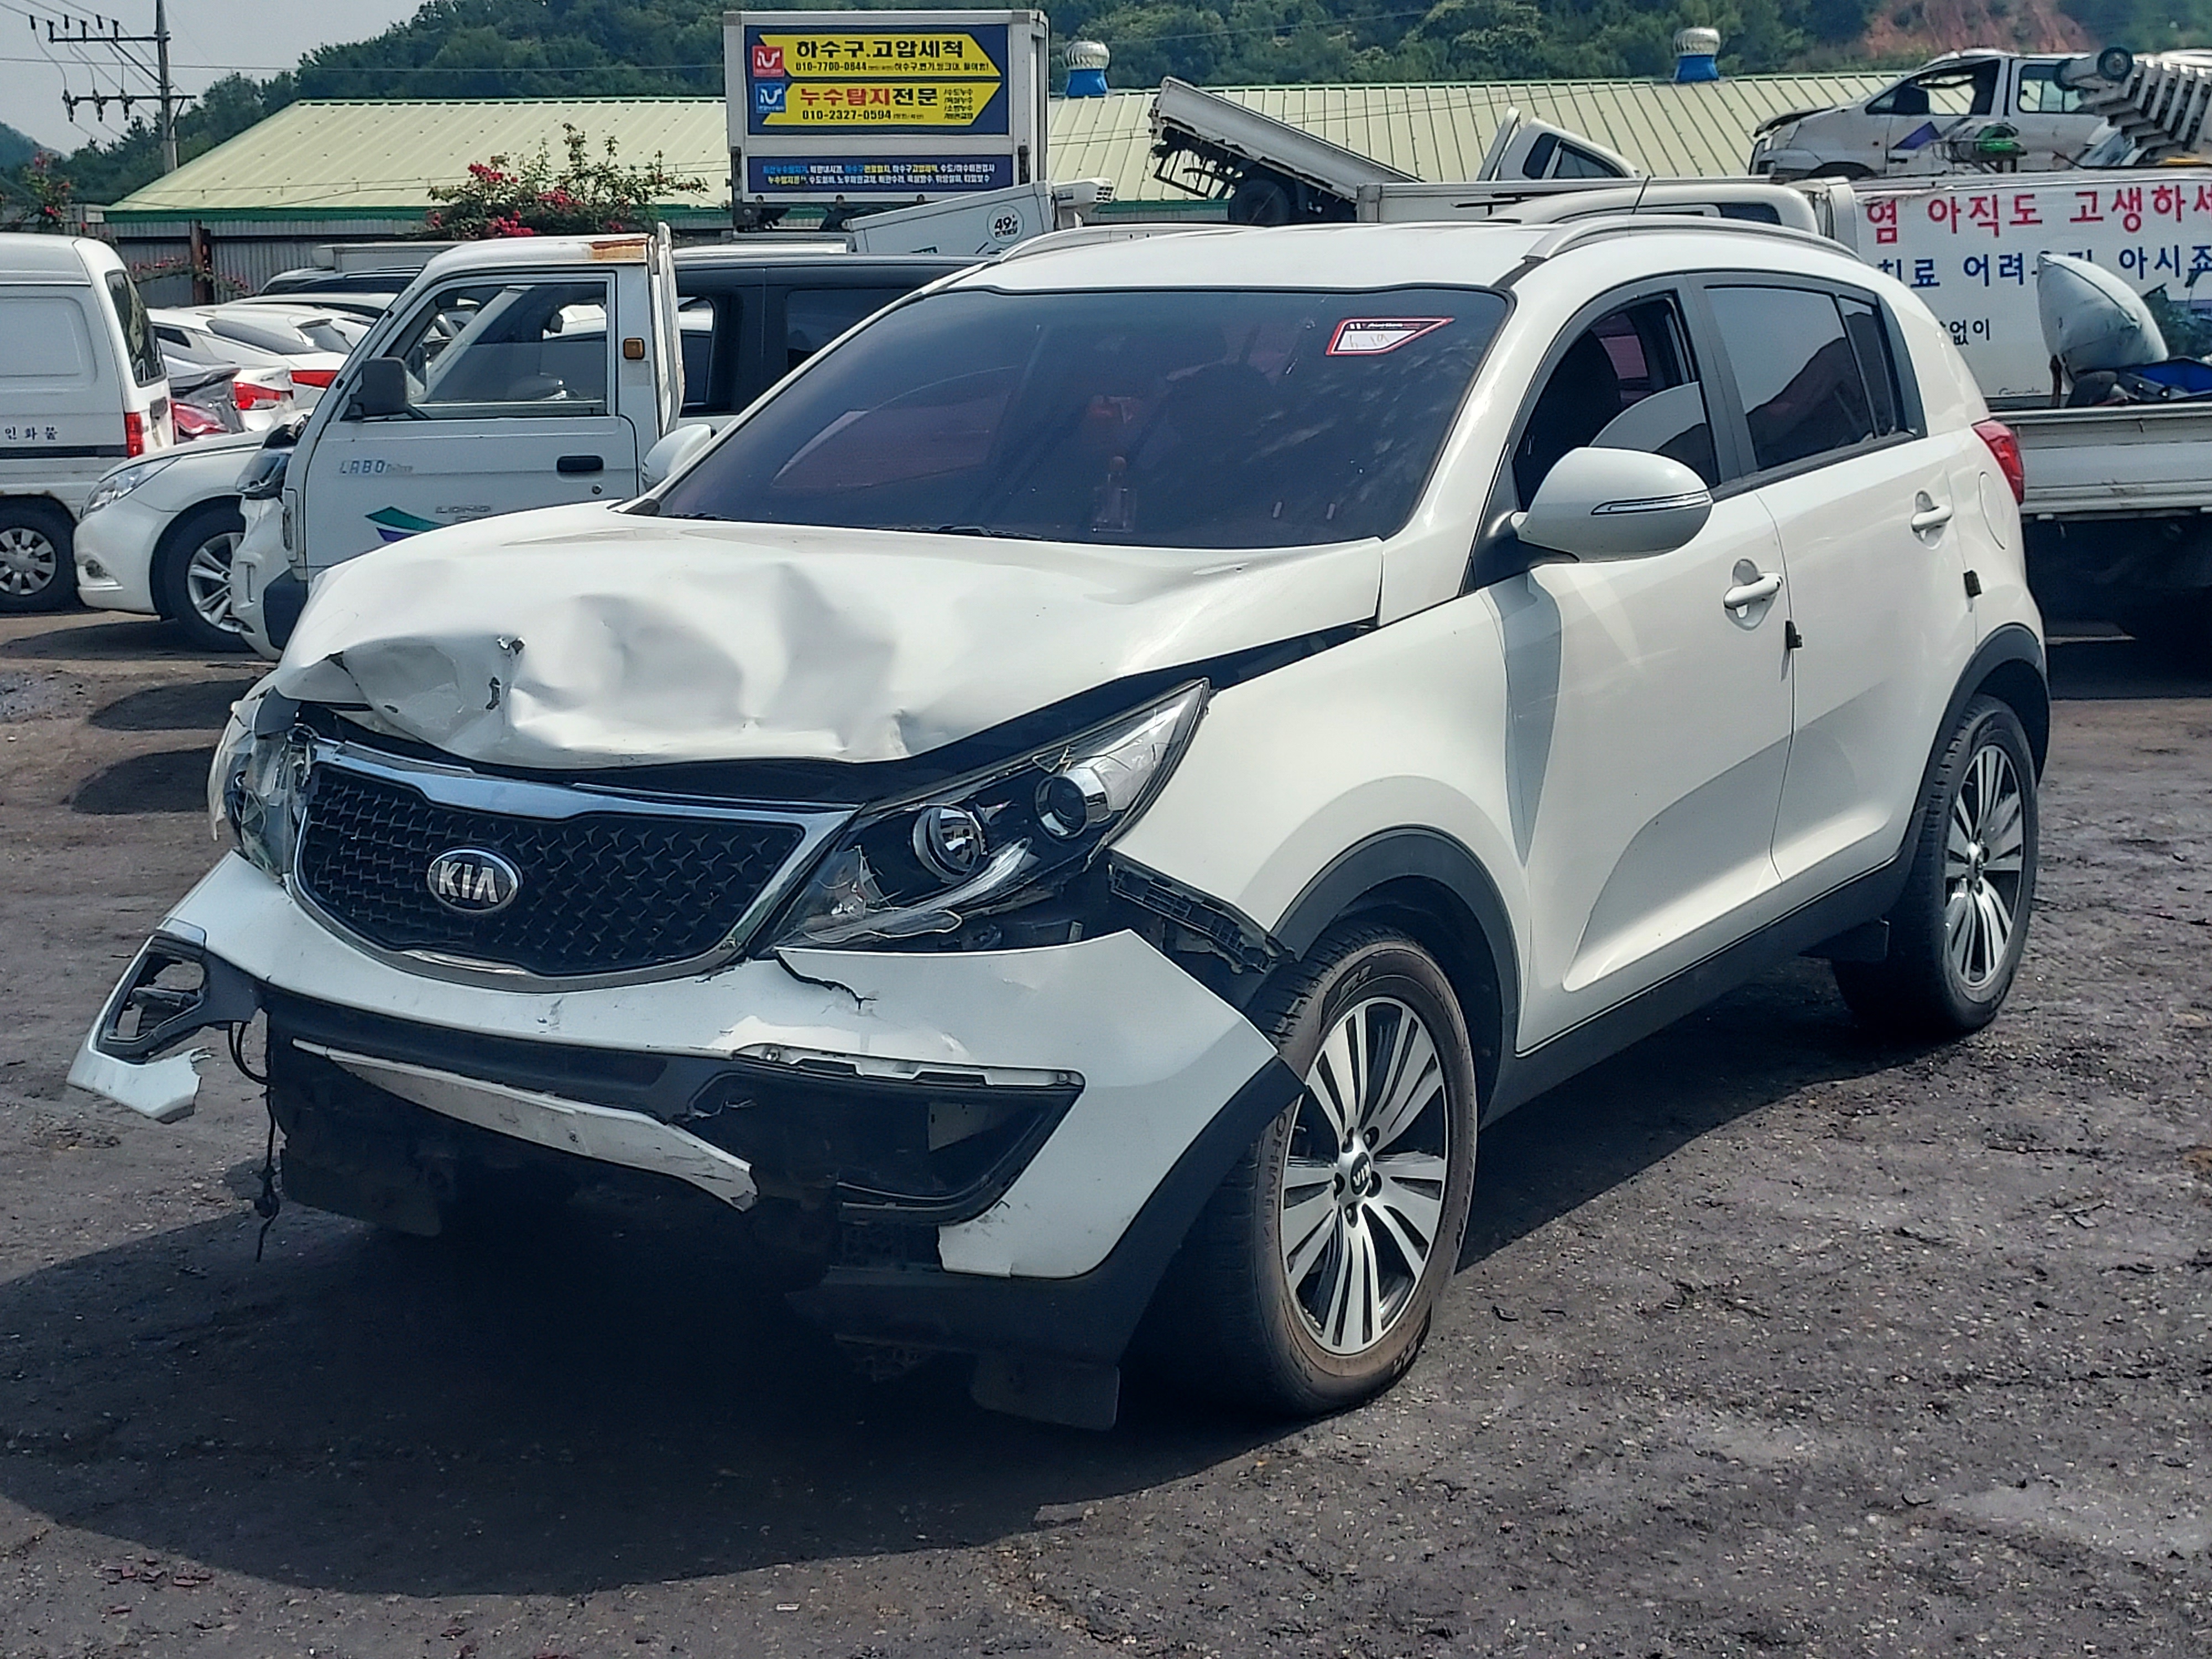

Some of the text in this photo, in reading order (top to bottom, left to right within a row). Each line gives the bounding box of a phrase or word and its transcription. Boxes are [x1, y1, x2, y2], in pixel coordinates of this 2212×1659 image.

[797, 41, 963, 58] 하수구.고압세척
[800, 88, 937, 106] 누수탐지전문
[802, 110, 891, 120] 010-2327-0594
[1867, 198, 1897, 243] 염
[1928, 194, 2042, 238] 아직도
[1964, 251, 2092, 286] 어려
[1939, 319, 1990, 345] 없이
[340, 460, 385, 474] LABO
[439, 860, 498, 902] KIA
[1353, 1161, 1370, 1186] KIA
